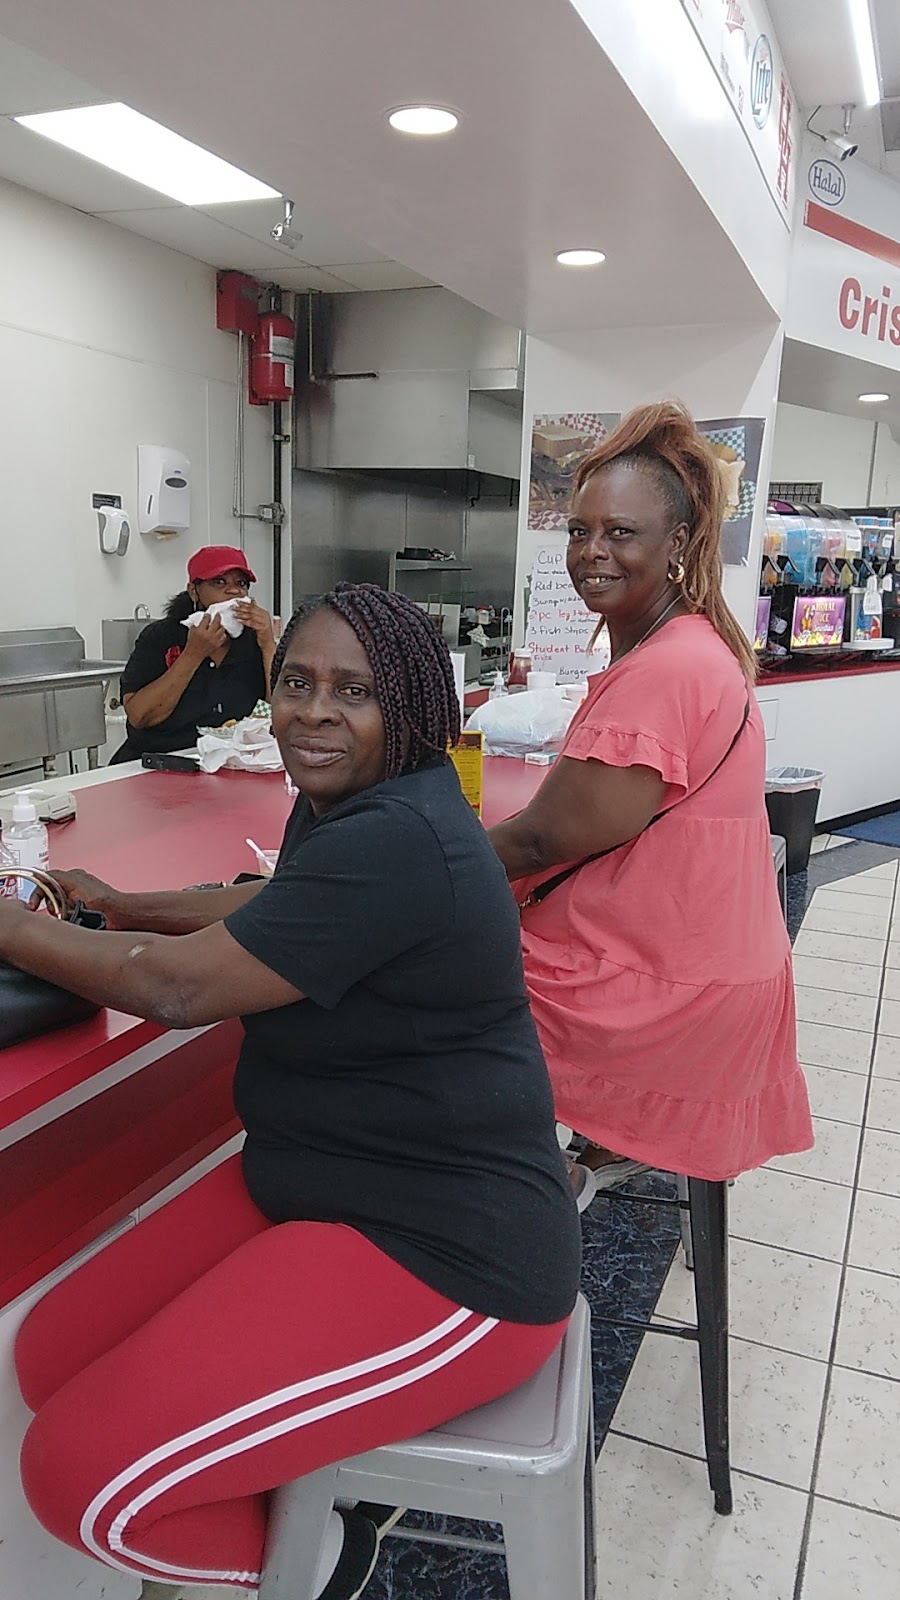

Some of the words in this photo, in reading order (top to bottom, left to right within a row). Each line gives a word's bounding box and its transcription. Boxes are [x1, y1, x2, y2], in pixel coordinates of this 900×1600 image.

[812, 165, 842, 198] Halal
[537, 550, 563, 565] Cup
[534, 580, 552, 591] Red
[539, 625, 561, 636] fish
[528, 641, 570, 654] Student
[559, 666, 589, 680] Burger
